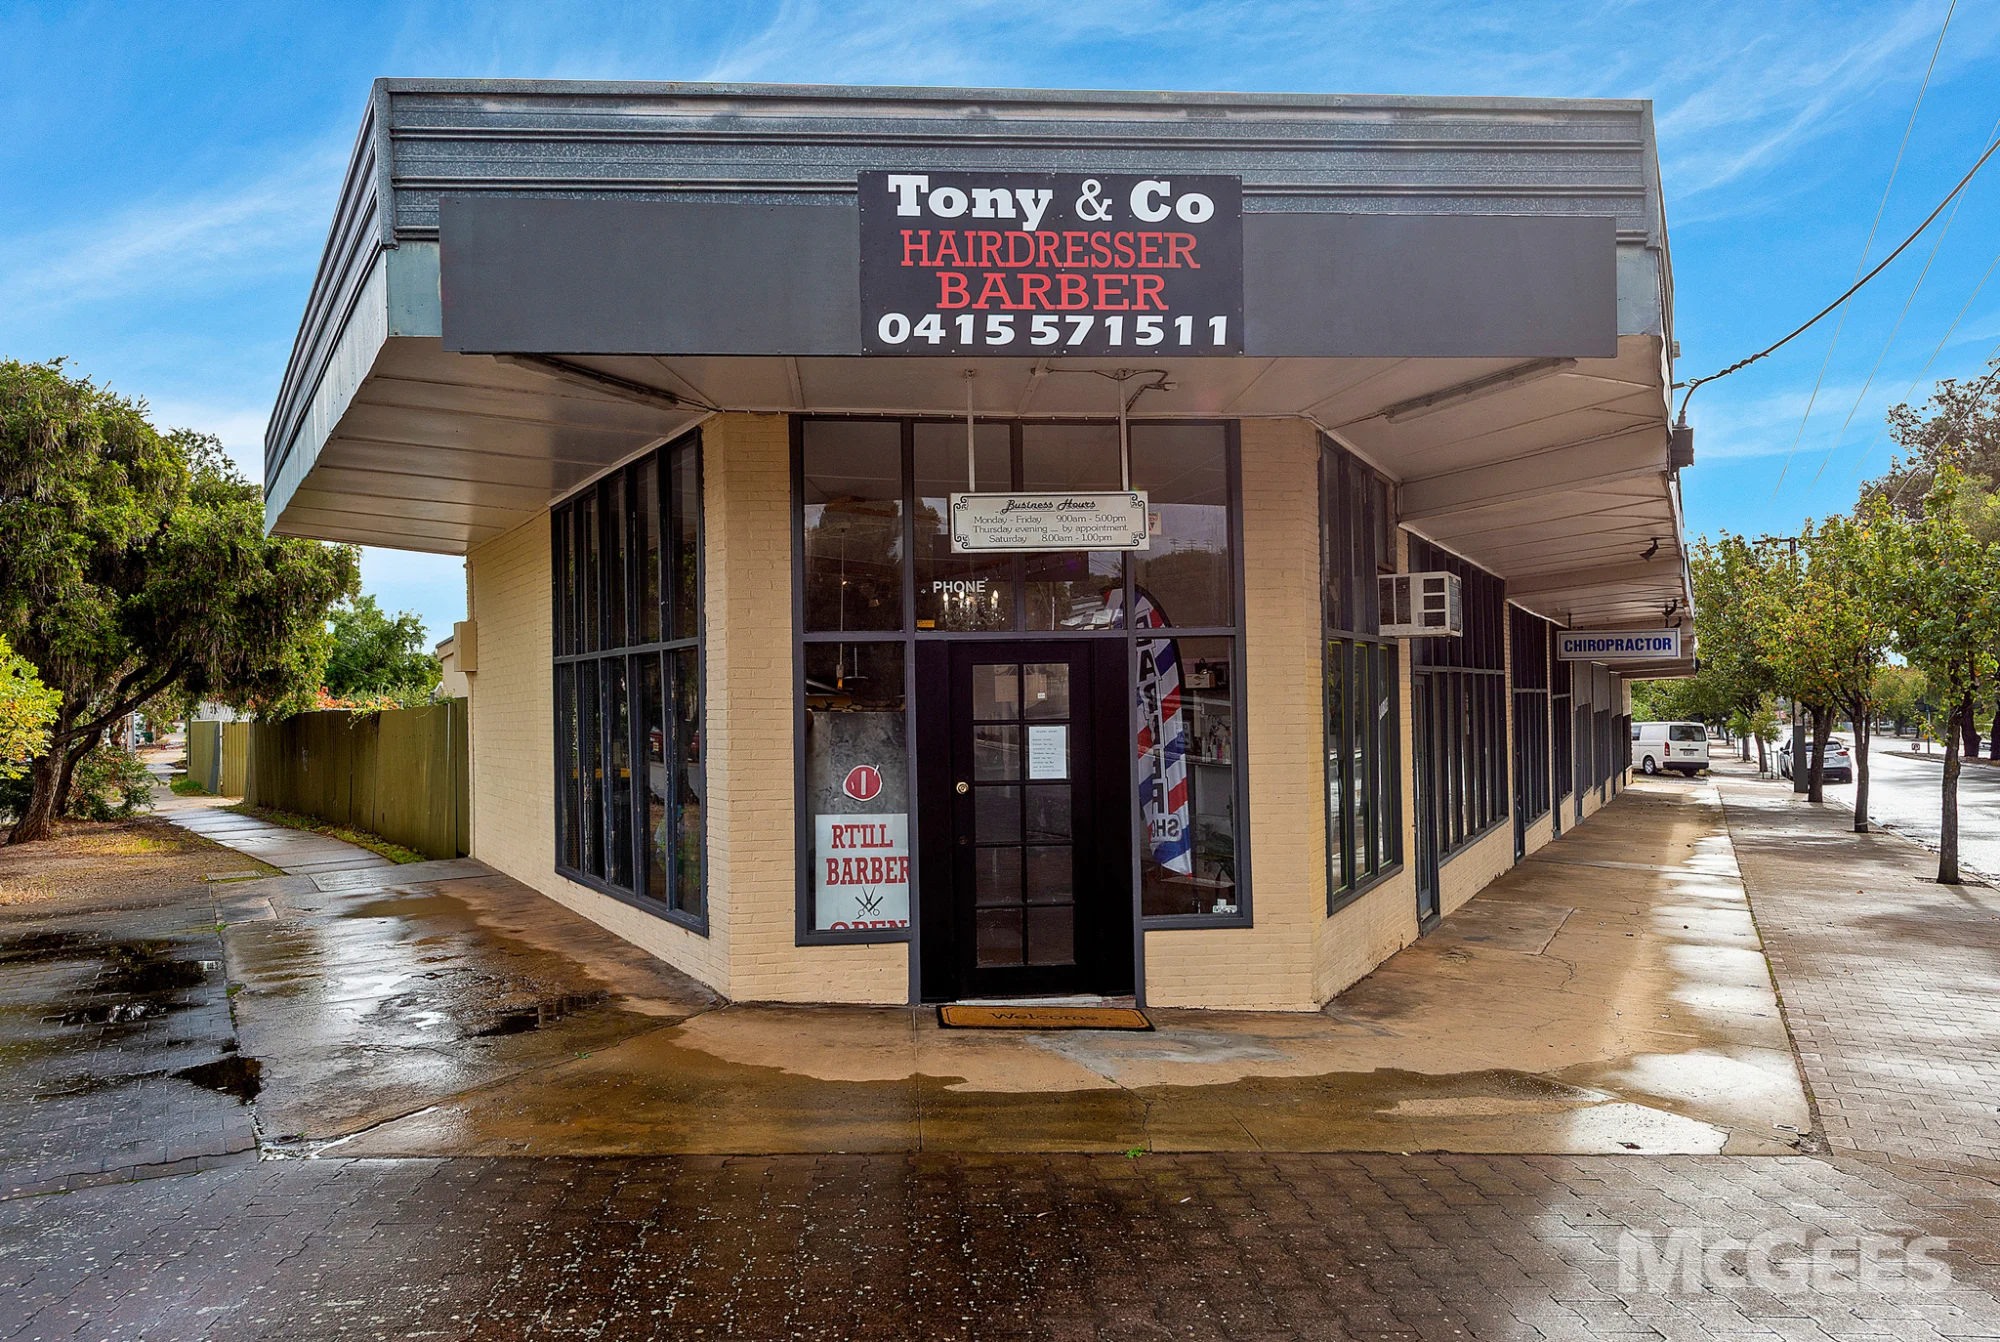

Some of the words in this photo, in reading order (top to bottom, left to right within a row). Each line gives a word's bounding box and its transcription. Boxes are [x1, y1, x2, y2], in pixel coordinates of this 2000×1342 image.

[888, 174, 1053, 231] Tony
[1075, 179, 1113, 221] &
[1130, 180, 1215, 223] Co
[900, 229, 1200, 269] HAIRDRESSER
[936, 272, 1169, 311] BARBER
[878, 313, 1015, 345] 0415
[1000, 500, 1053, 515] Business
[1057, 499, 1096, 511] Hours
[973, 515, 1007, 525] Monday
[1016, 515, 1042, 525] Friday
[973, 525, 1012, 534] Thursday
[1015, 525, 1048, 533] evening
[1062, 524, 1072, 533] by
[989, 534, 1027, 543] Saturday
[933, 581, 986, 593] PHONE
[1564, 637, 1672, 652] CHIROPRACTOR
[826, 856, 909, 886] BARBER
[989, 1012, 1098, 1021] Welcome
